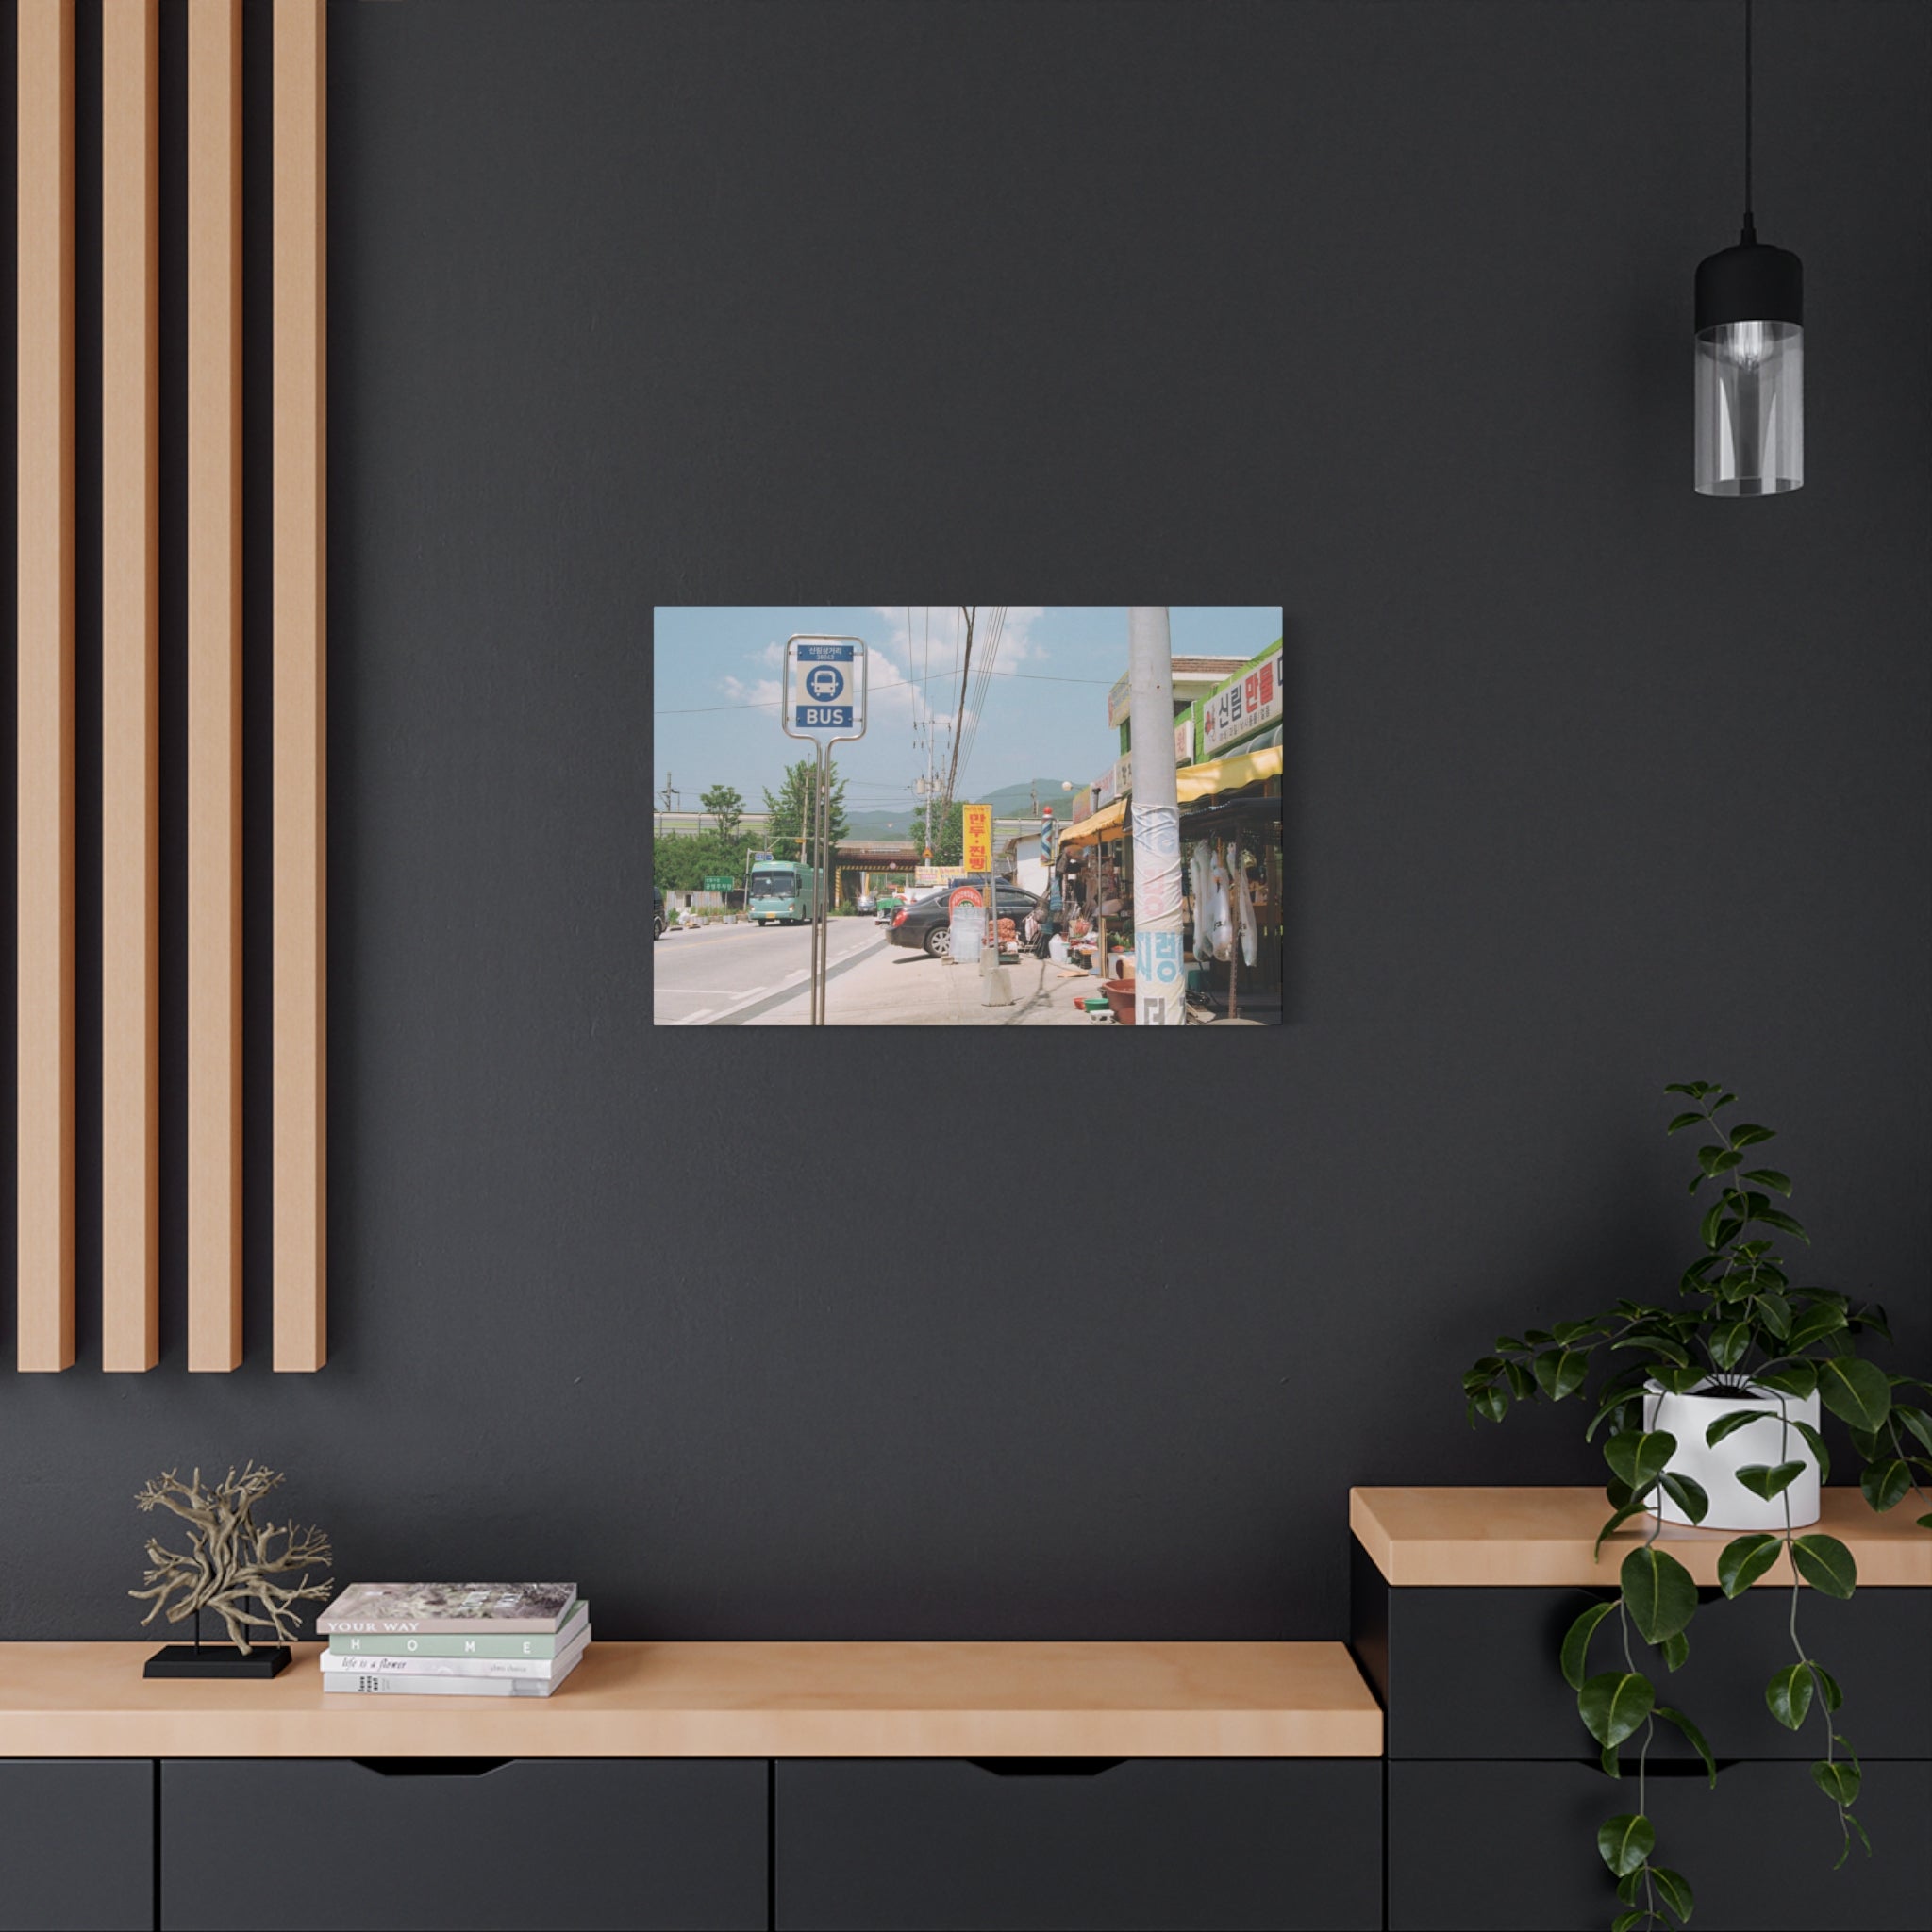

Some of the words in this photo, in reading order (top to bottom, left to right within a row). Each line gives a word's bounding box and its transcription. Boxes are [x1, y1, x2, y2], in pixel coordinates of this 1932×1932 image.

[1218, 685, 1242, 728] 신림
[1245, 662, 1274, 714] 만물
[807, 708, 843, 724] BUS
[328, 1622, 376, 1632] YOUR
[383, 1622, 420, 1632] WAY
[351, 1638, 531, 1654] HOME
[342, 1657, 357, 1670] life
[377, 1657, 407, 1672] flower
